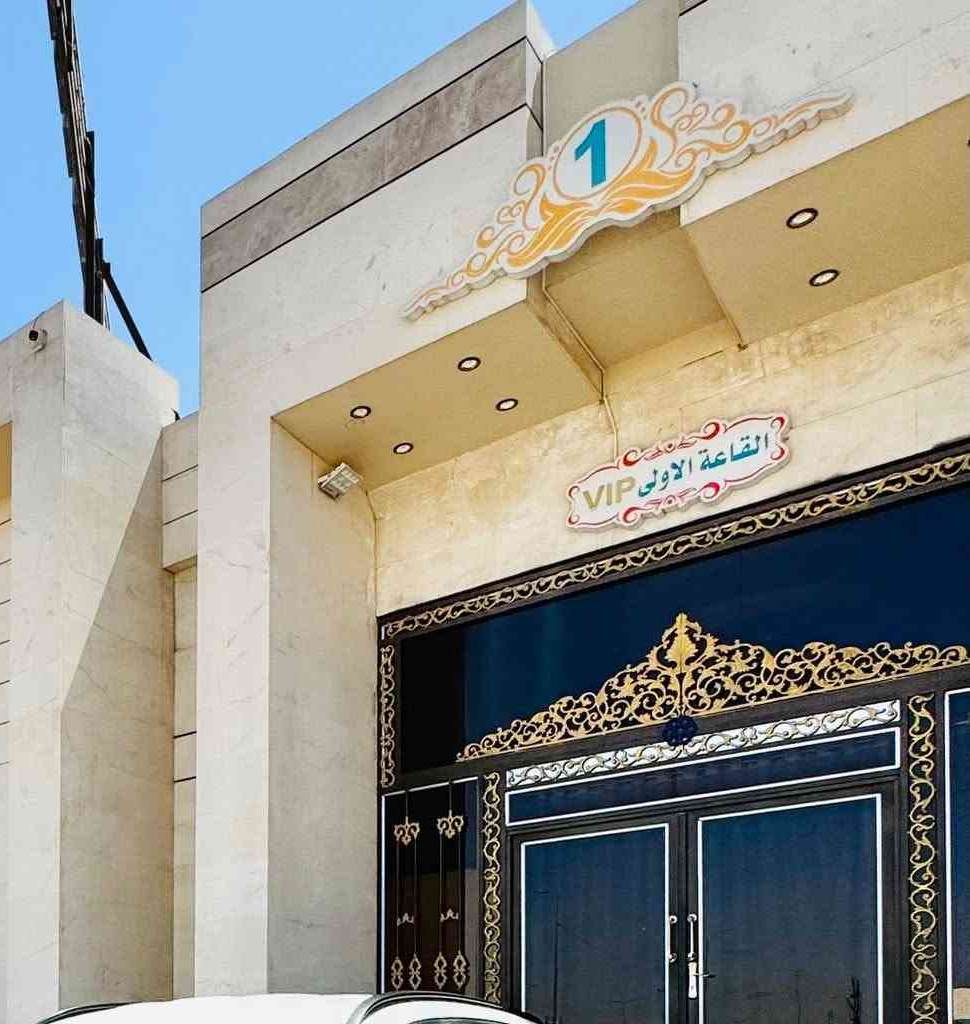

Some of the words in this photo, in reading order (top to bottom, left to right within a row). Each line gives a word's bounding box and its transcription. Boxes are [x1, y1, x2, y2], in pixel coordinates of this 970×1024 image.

[574, 119, 606, 188] 1
[700, 433, 769, 471] القاعة
[582, 476, 636, 510] VIP
